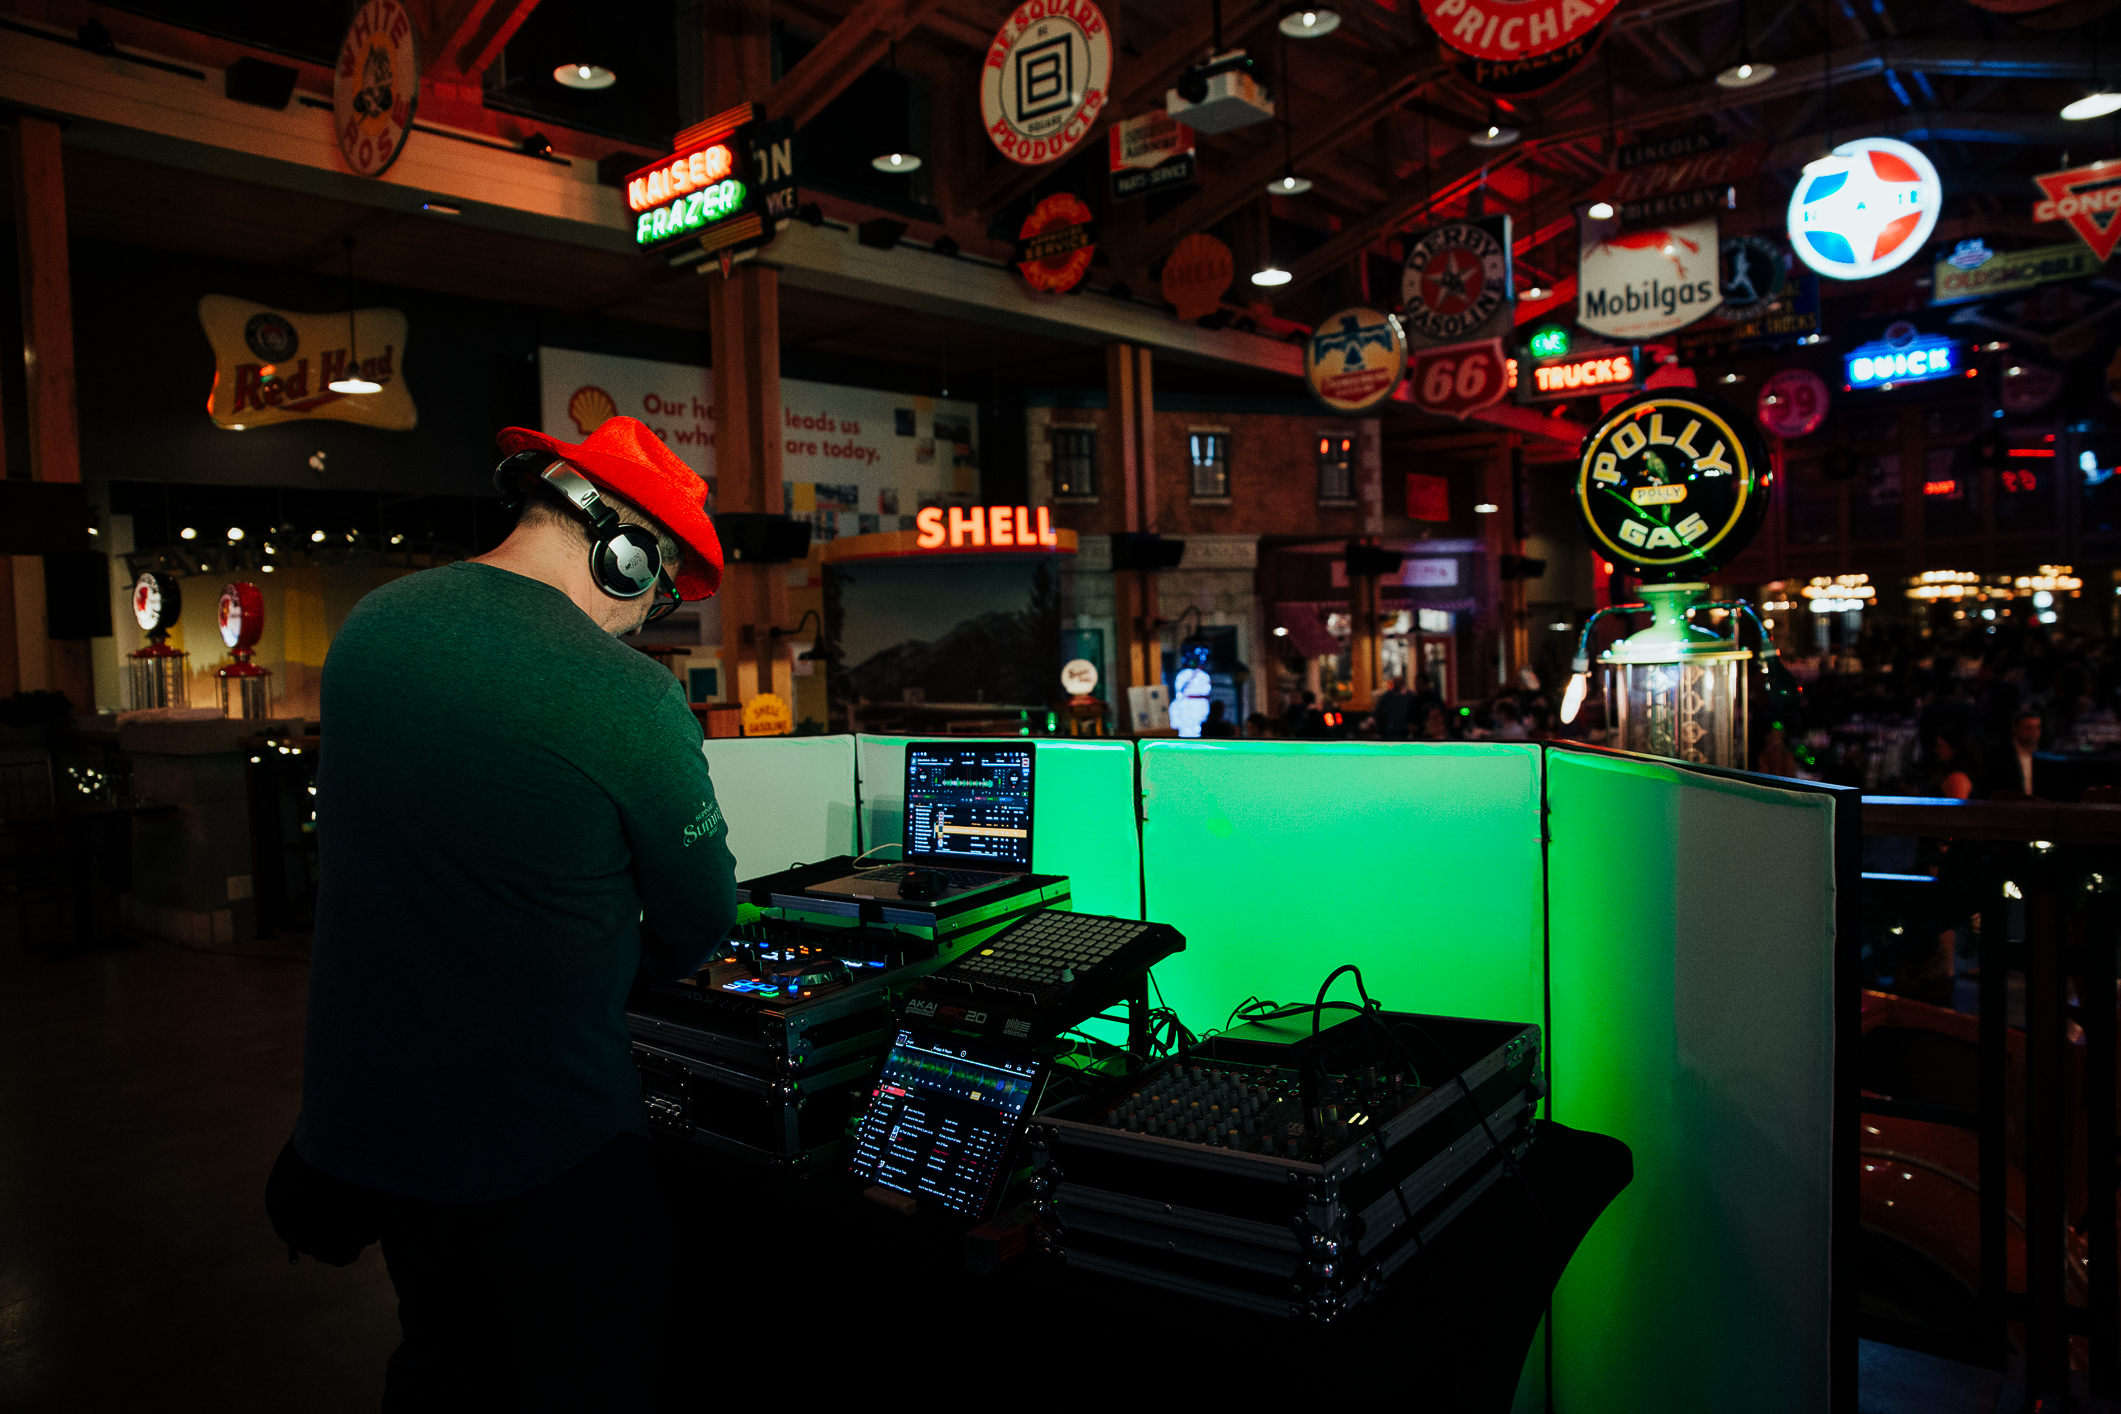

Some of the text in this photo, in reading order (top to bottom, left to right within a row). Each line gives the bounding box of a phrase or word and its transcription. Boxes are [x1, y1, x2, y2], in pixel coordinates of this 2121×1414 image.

[341, 1, 408, 78] WHITE
[1434, 0, 1606, 52] PRICHA
[343, 93, 410, 168] ROSE
[992, 89, 1100, 160] PRODUCTS
[629, 144, 733, 212] KAISER
[637, 179, 747, 244] FRAZER
[1409, 226, 1498, 273] DERBY
[1408, 275, 1501, 338] GASOLINE
[1586, 278, 1712, 319] Mobilgas
[232, 345, 394, 416] Red Had
[1423, 353, 1489, 401] 66
[1534, 356, 1633, 392] TRUCKS
[1850, 347, 1952, 383] BUICK
[644, 393, 687, 417] Our
[785, 406, 836, 433] leads
[841, 420, 861, 436] us
[785, 439, 818, 457] are
[823, 438, 881, 466] today.
[1592, 413, 1733, 485] POLLY
[1637, 487, 1682, 500] POLLY
[916, 505, 1058, 549] SHELL
[1618, 511, 1709, 550] GAS
[651, 981, 710, 1003] DENON DJ
[907, 998, 938, 1012] AKAI
[1003, 1029, 1028, 1039] ableton
